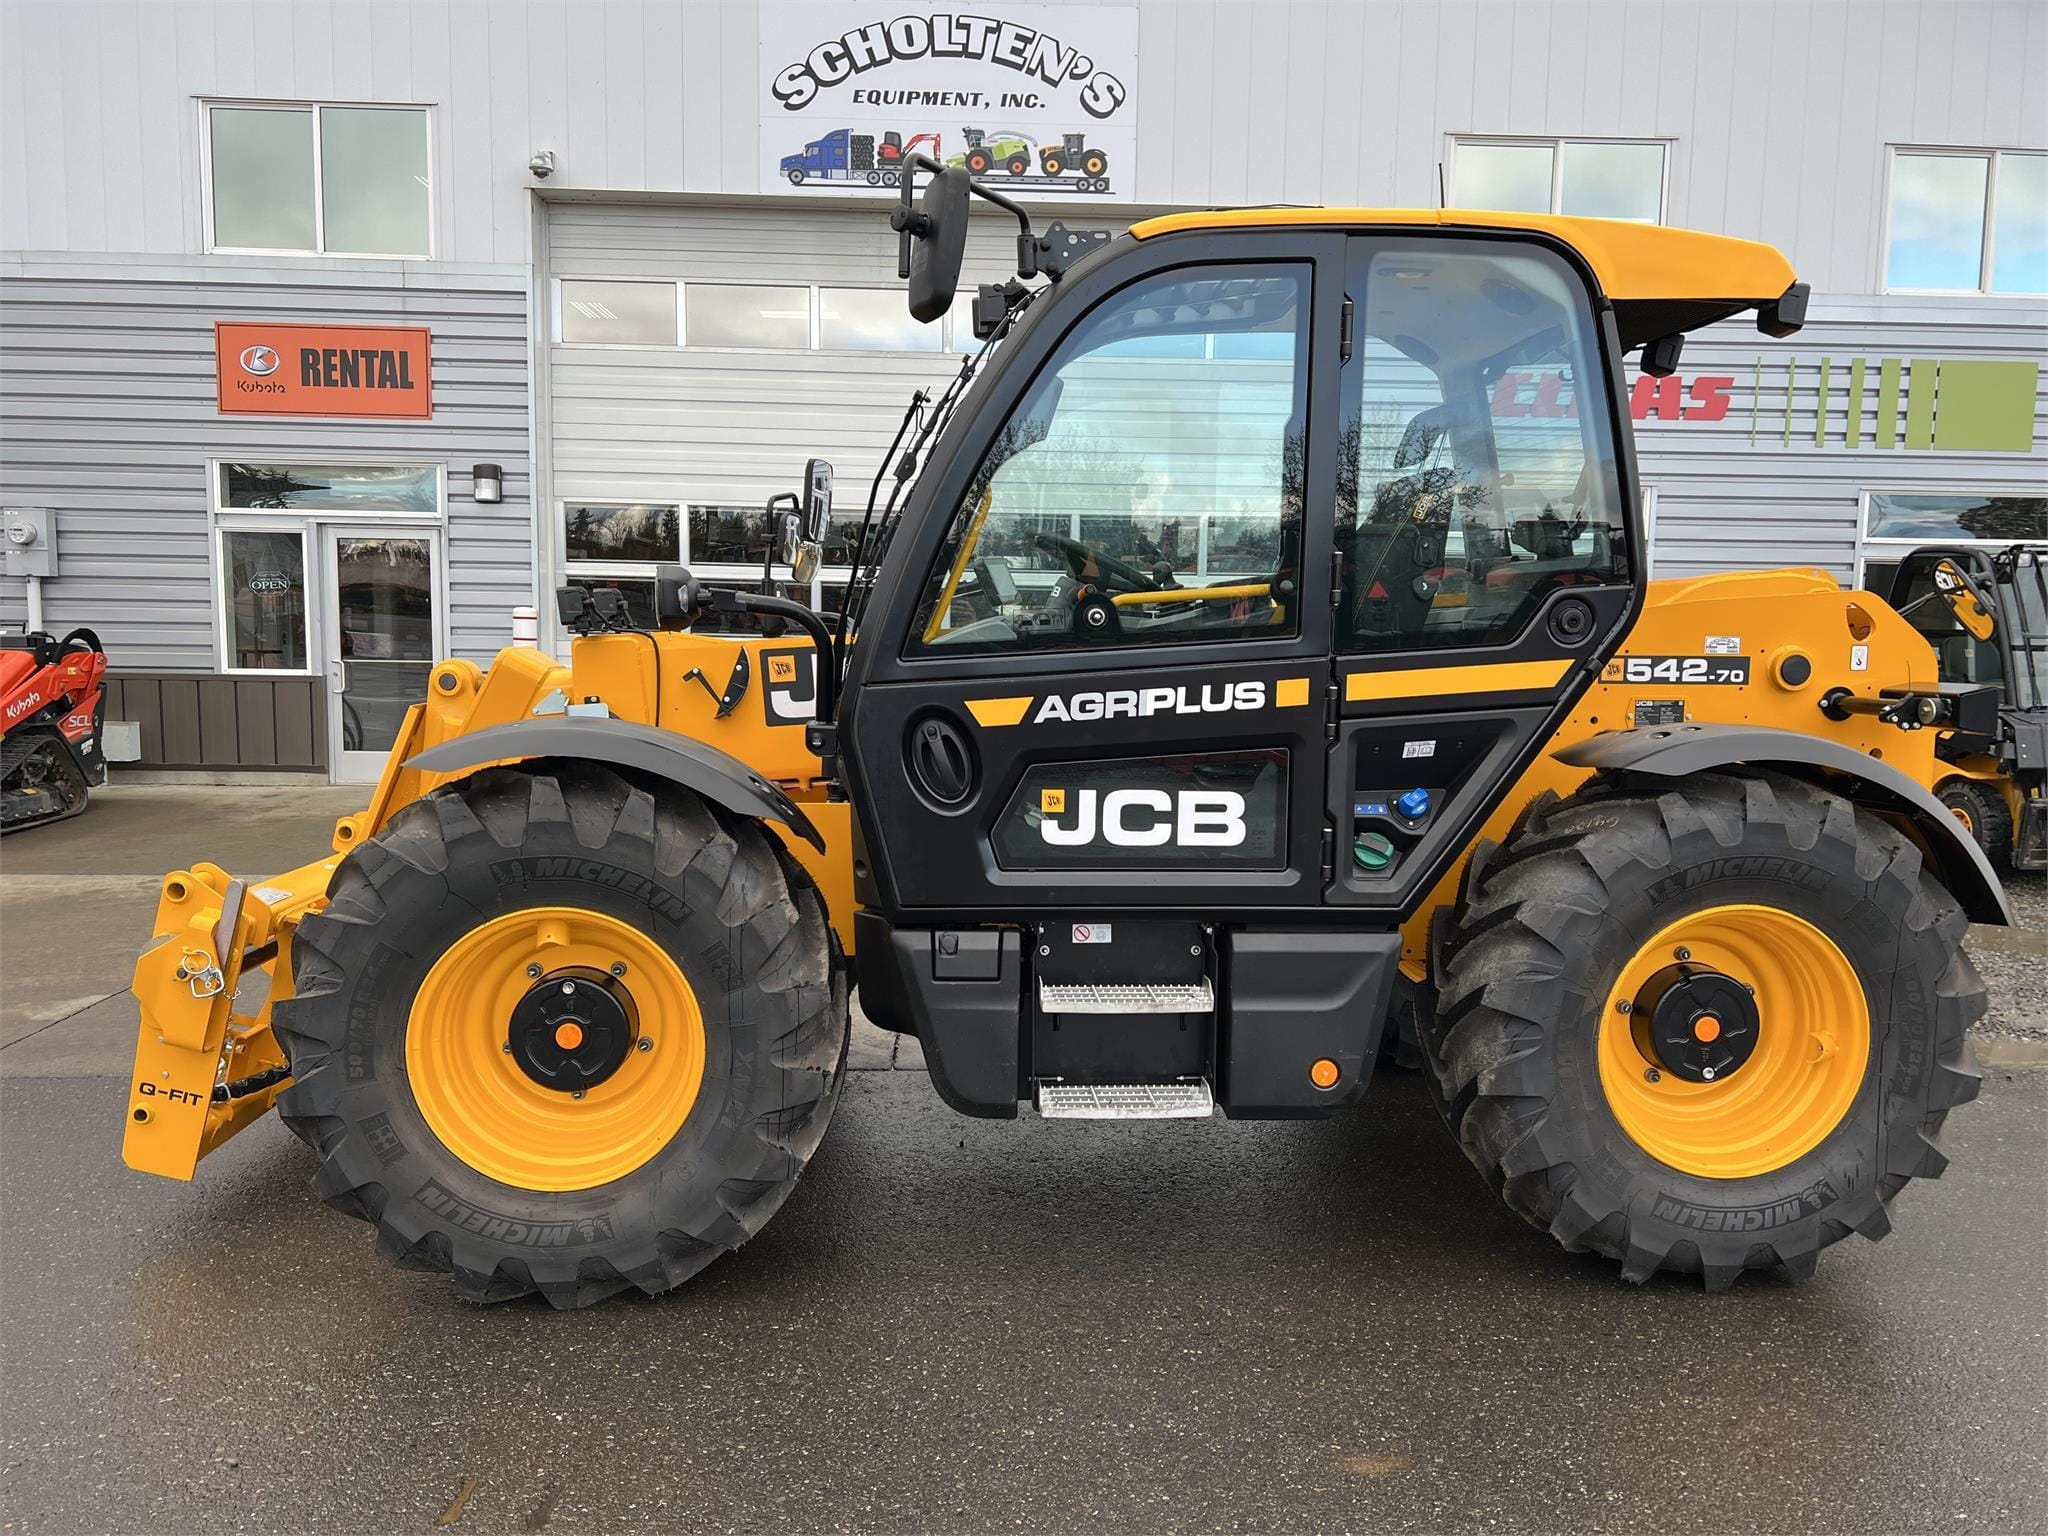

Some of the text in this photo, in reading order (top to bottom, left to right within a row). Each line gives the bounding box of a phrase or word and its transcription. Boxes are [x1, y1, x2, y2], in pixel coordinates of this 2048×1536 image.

[772, 14, 1126, 118] SCHOLTEN'S
[852, 89, 1046, 109] EQUIPMENT, INC.
[300, 348, 415, 389] RENTAL
[237, 380, 286, 393] Kubota
[251, 580, 288, 590] OPEN
[6, 691, 40, 718] Kubota
[1033, 681, 1266, 724] AGRIPLUS
[69, 715, 92, 728] SCL
[1041, 789, 1247, 847] JCB
[1686, 857, 1831, 889] MICHELIN
[535, 858, 690, 921] MICHELIN
[139, 1082, 203, 1106] Q-FIT
[419, 1187, 571, 1246] MICHELIN
[1654, 1199, 1800, 1231] MICHELIN
